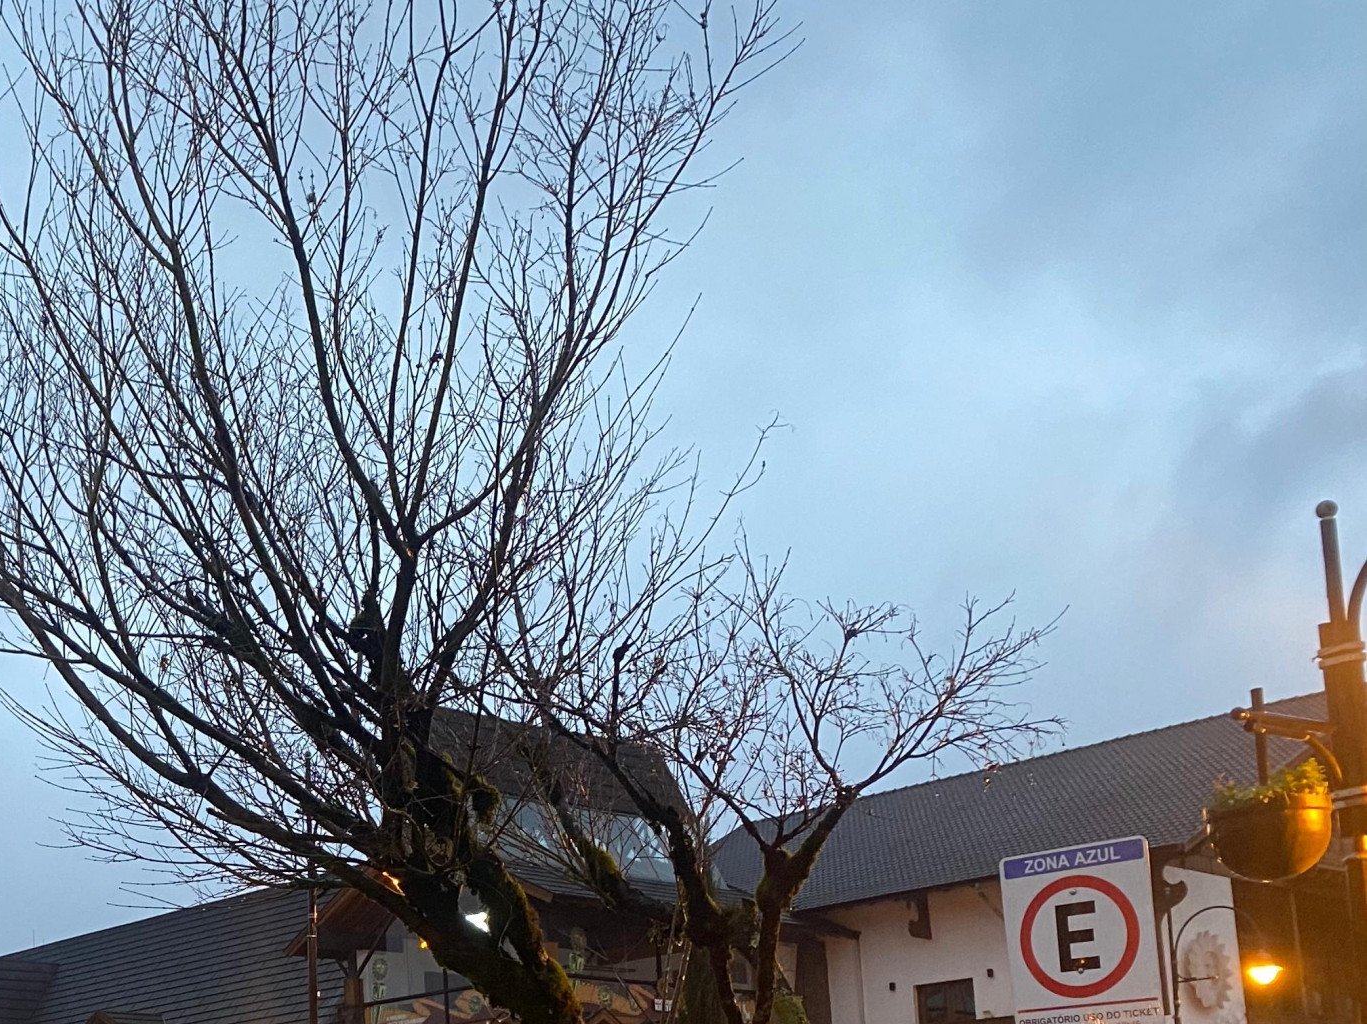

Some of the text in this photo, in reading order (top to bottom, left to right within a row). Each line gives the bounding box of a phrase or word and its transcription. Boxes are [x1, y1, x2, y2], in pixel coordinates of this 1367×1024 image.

[1024, 846, 1121, 874] ZONA AZUL
[1055, 900, 1101, 972] E
[1083, 1011, 1104, 1022] USO
[1107, 1011, 1121, 1020] DO
[1123, 1007, 1159, 1018] TICKET
